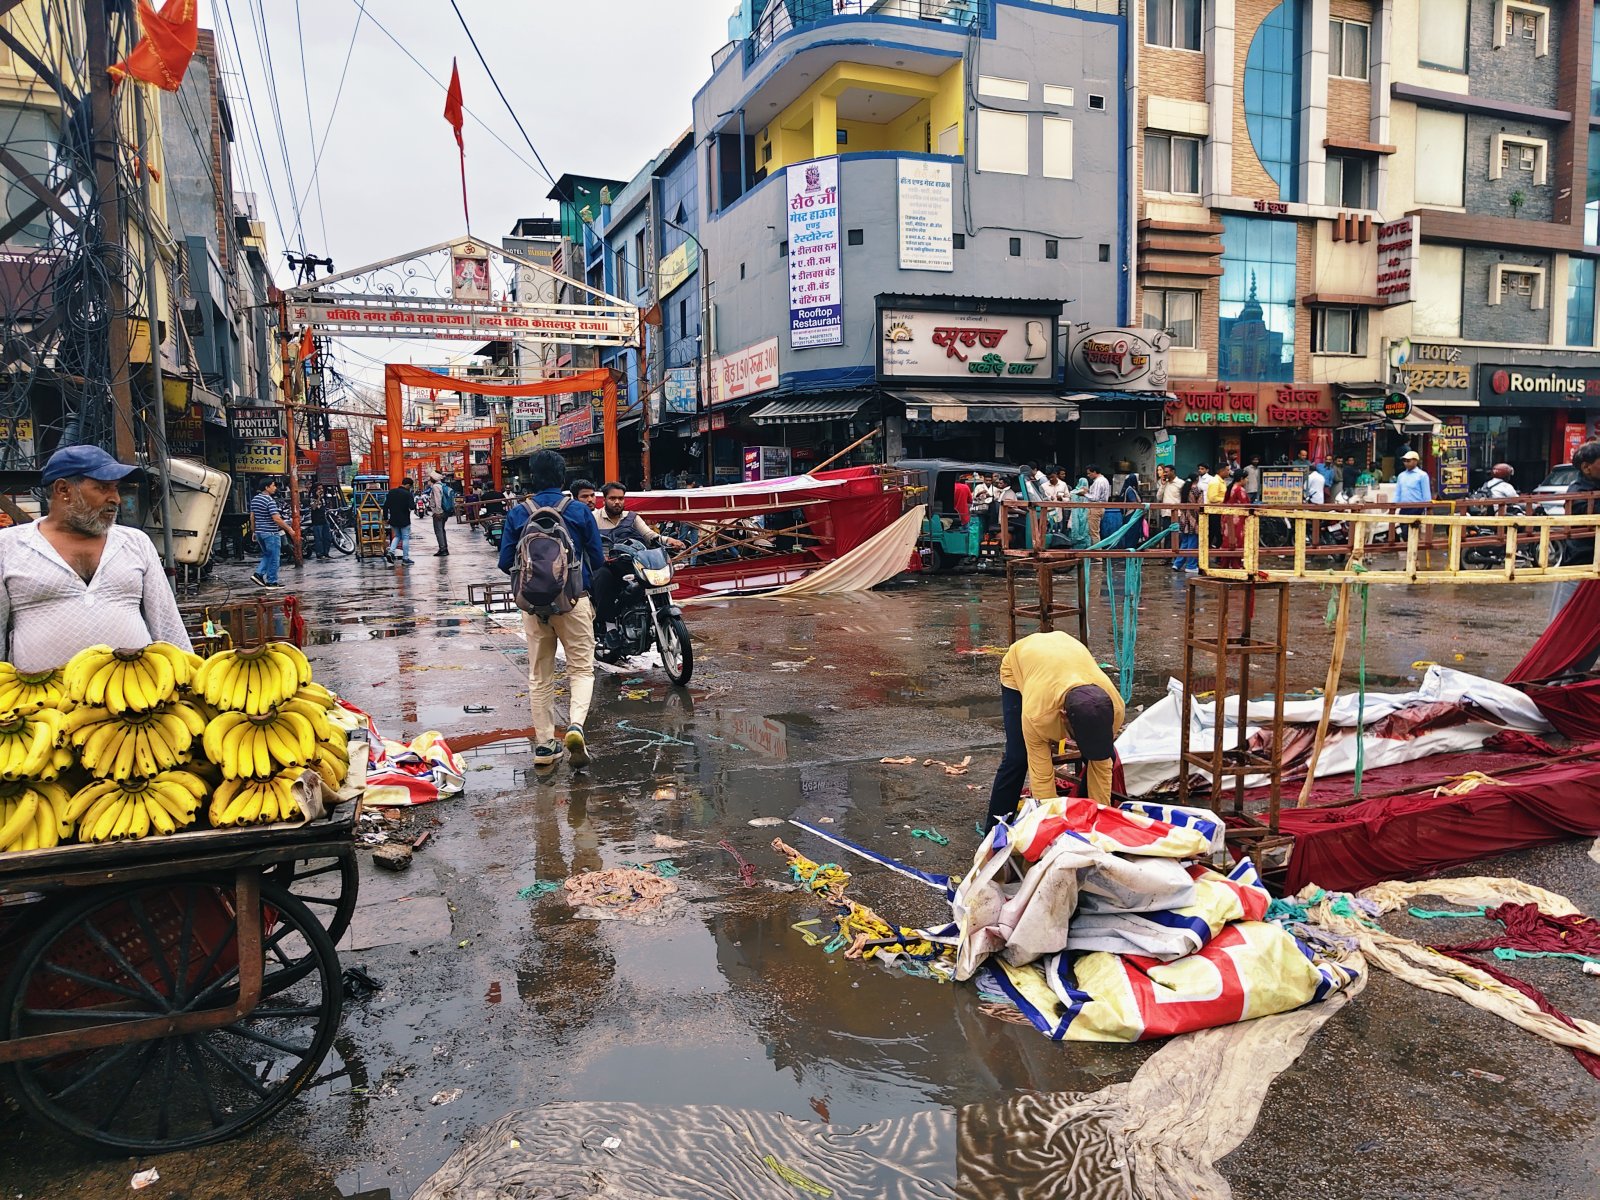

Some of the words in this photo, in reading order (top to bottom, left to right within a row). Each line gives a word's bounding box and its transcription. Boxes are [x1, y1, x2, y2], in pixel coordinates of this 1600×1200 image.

[790, 193, 815, 209] सेठ
[790, 211, 807, 222] गेस्ट
[805, 222, 821, 230] एण्ड
[1377, 221, 1412, 240] HOTEL
[1388, 257, 1400, 267] AC
[1397, 269, 1411, 279] AC
[1377, 282, 1410, 296] ROOMS
[798, 308, 833, 319] Rooftop
[363, 312, 387, 321] नगर
[417, 314, 435, 323] सब
[532, 318, 576, 330] कोसलपुर
[792, 315, 841, 328] Restaurant
[932, 327, 1008, 362] सूरज
[1399, 361, 1471, 394] geeta
[1511, 373, 1586, 392] Rominus
[1278, 385, 1322, 404] होटल
[1229, 392, 1258, 411] ढाबा
[235, 408, 275, 418] HOTEL
[1185, 412, 1199, 422] AC
[1267, 404, 1332, 425] चित्रकूट
[233, 419, 279, 428] FRONTIER
[238, 428, 276, 437] PRIME
